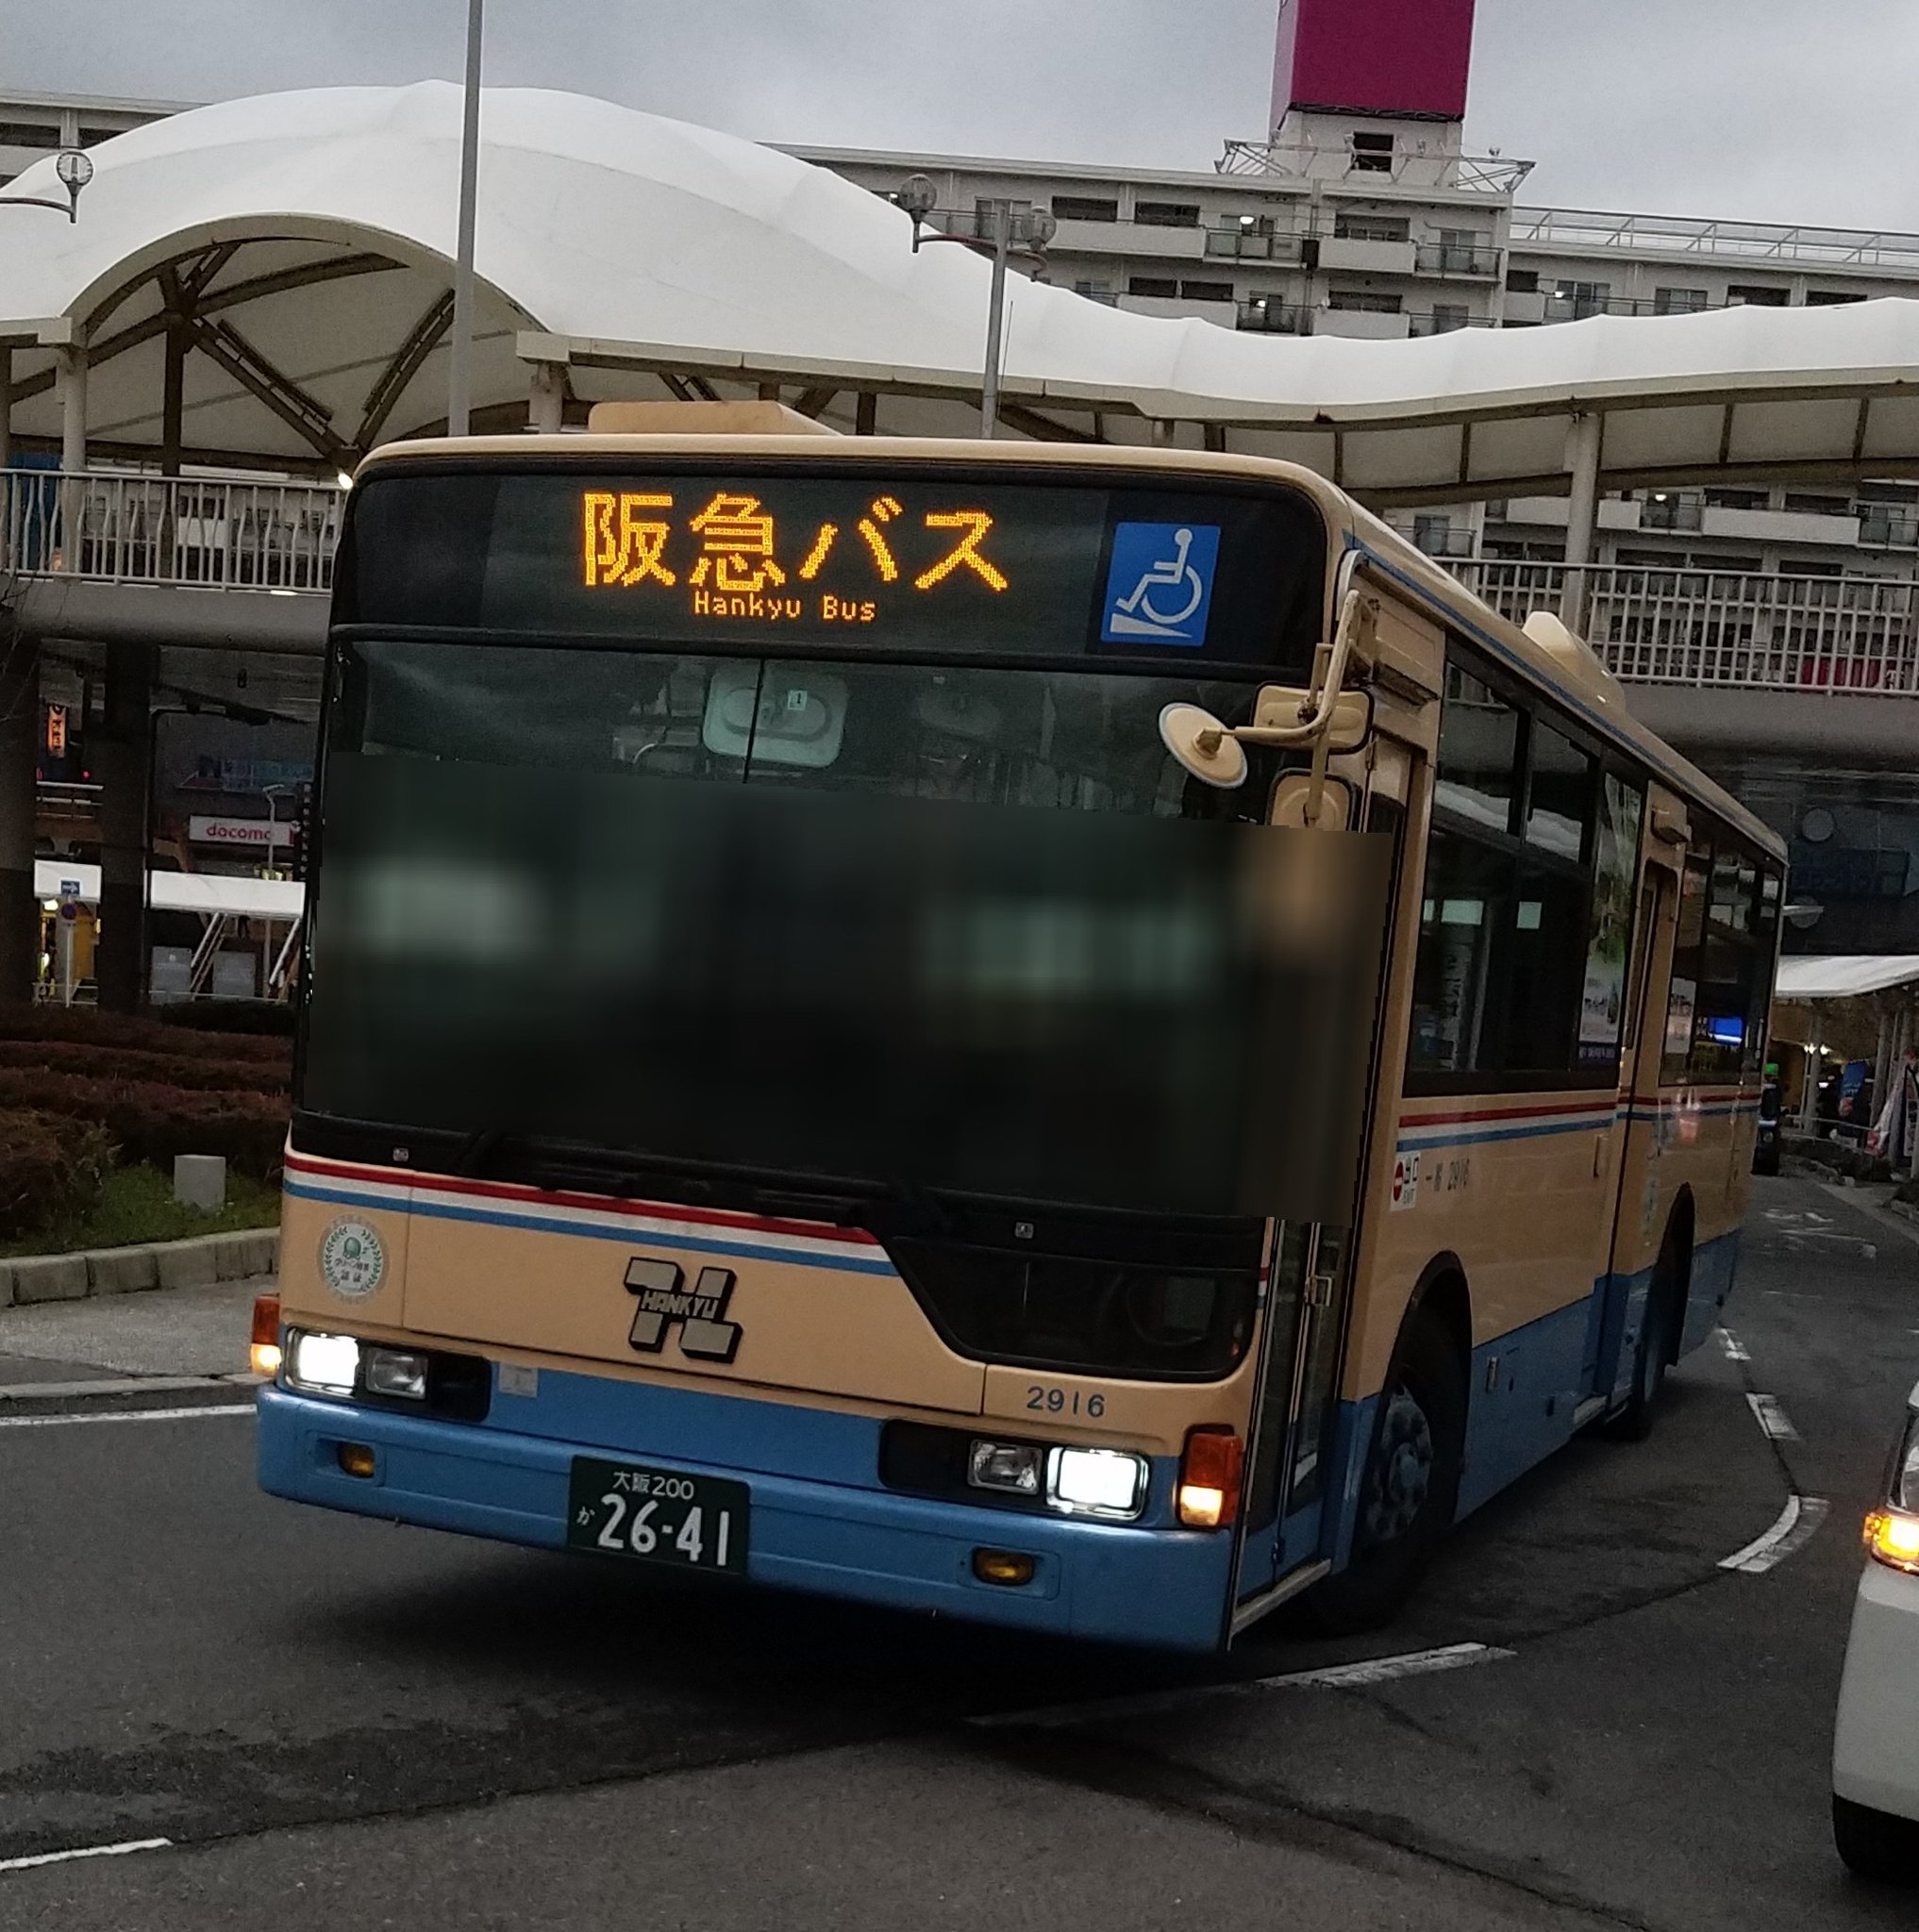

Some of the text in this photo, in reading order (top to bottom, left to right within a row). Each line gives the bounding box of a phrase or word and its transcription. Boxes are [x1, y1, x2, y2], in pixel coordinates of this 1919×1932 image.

[583, 491, 1009, 591] 阪急バス
[693, 591, 876, 622] Hankyu Bus
[641, 1290, 720, 1320] HANKYU
[1026, 1386, 1106, 1418] 2916
[597, 1493, 729, 1567] 26-41
